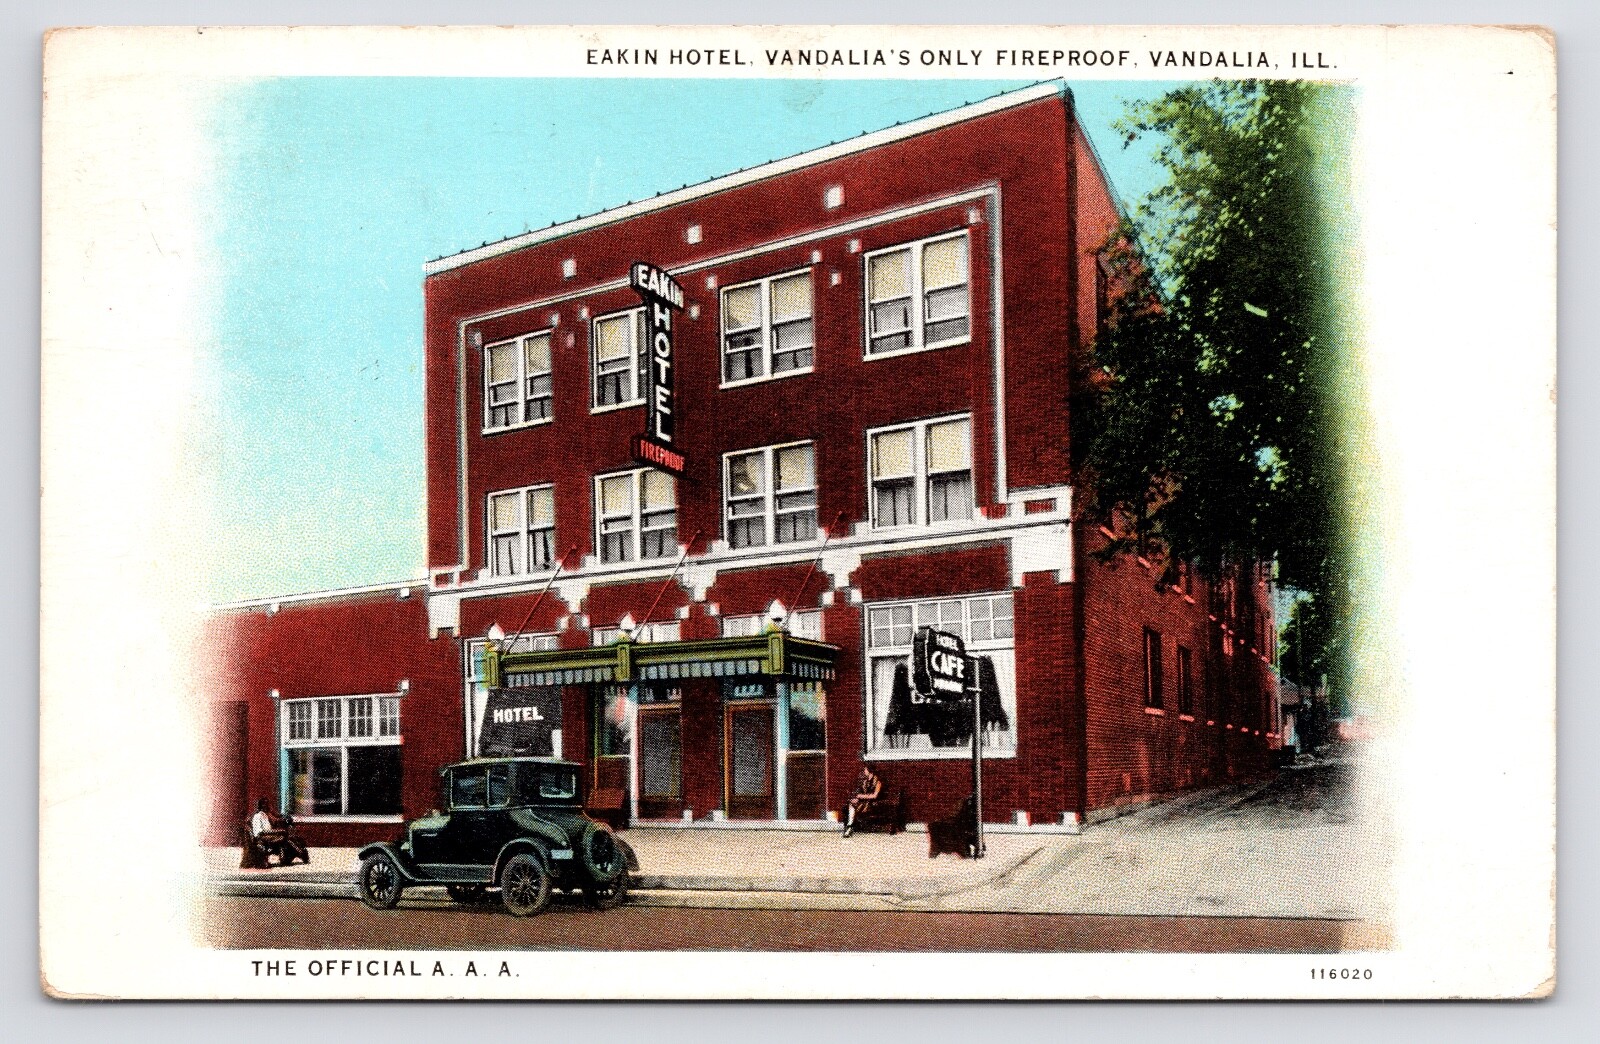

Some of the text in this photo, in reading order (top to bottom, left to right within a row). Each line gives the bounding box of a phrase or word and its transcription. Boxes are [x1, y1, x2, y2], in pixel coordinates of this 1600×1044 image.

[637, 264, 684, 308] EAKIN
[654, 302, 672, 442] HOTEL
[931, 651, 965, 678] CAFE
[493, 706, 544, 723] HOTEL
